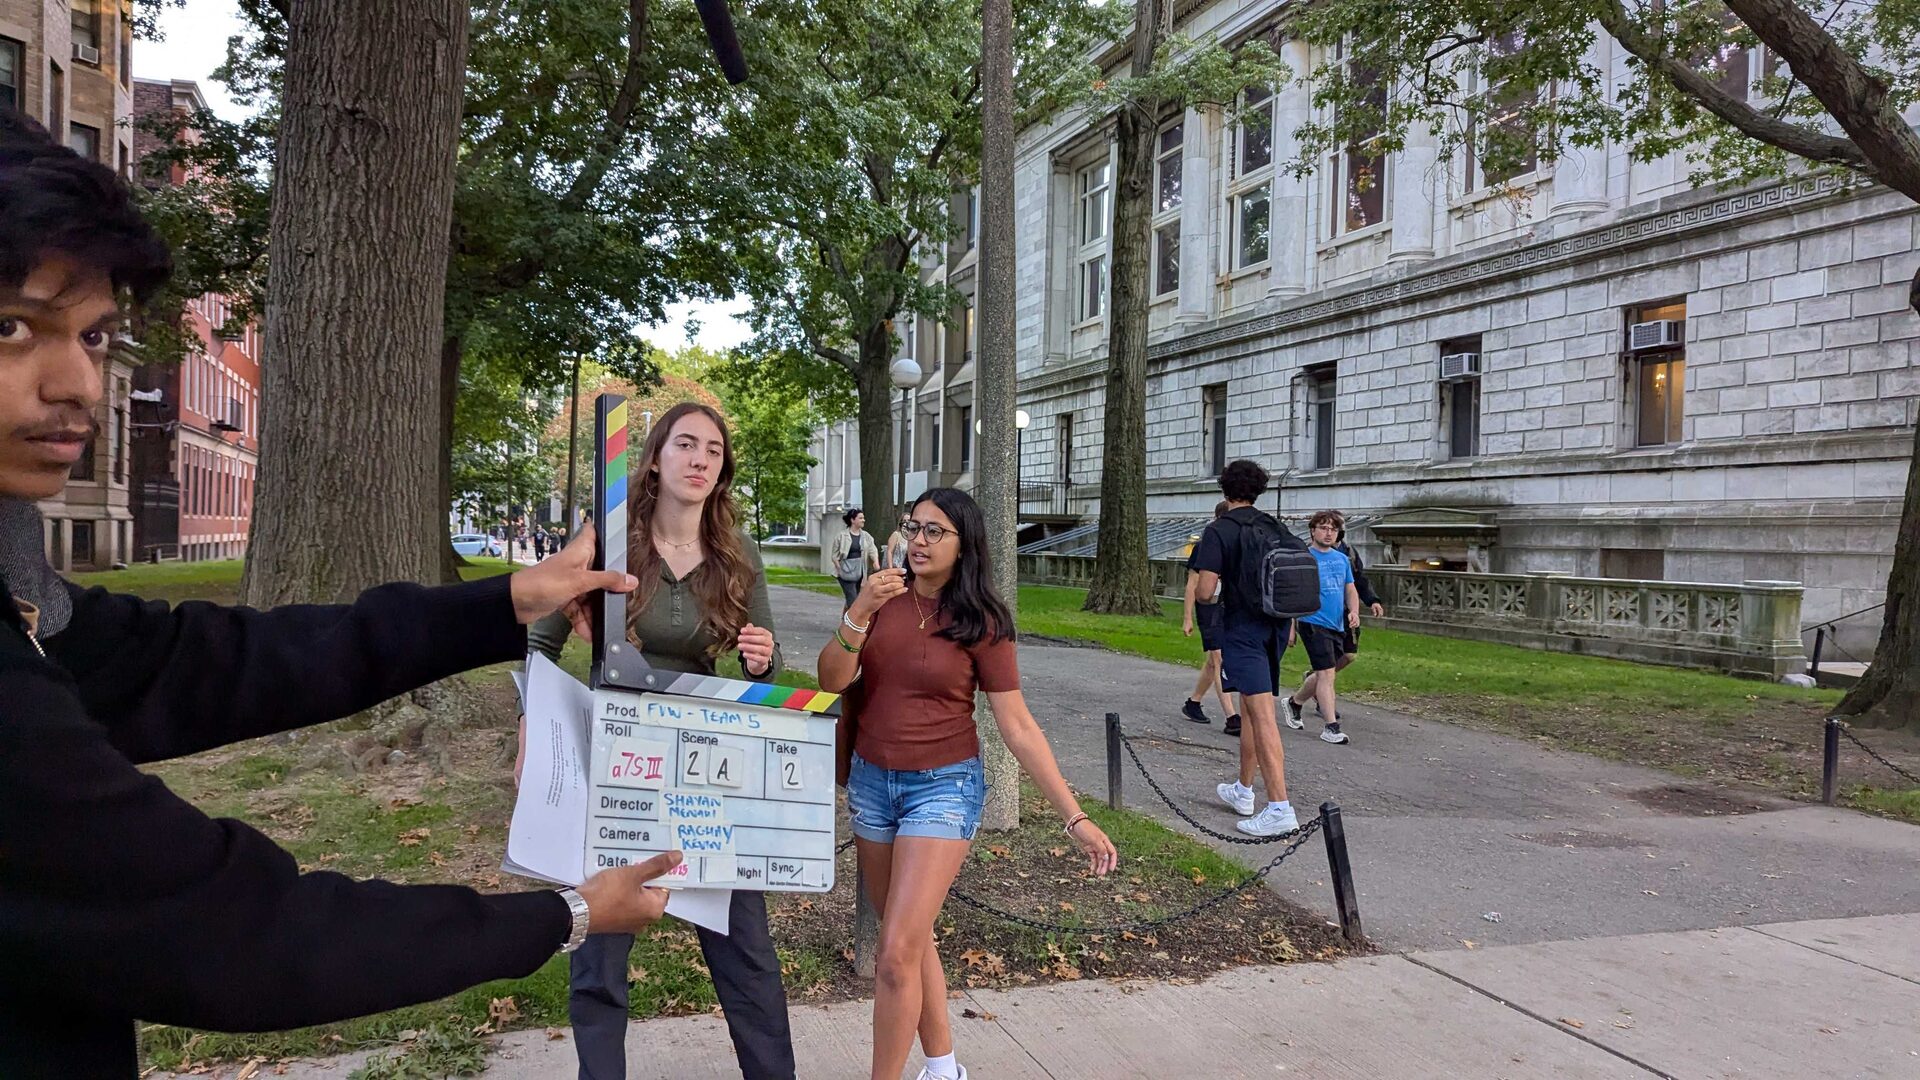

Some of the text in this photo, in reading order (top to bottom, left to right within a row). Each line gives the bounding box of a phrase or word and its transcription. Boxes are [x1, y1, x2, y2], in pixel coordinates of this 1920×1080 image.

[606, 702, 639, 718] Prod.
[700, 708, 742, 724] TEAM
[747, 713, 761, 729] 5
[605, 723, 632, 738] Roll
[681, 731, 719, 746] Scene
[768, 741, 798, 755] Take
[686, 750, 730, 781] 2 A
[784, 762, 799, 786] 2
[600, 795, 654, 812] Director
[663, 792, 722, 808] SHAYAN
[599, 826, 651, 842] Camera
[597, 853, 628, 868] Date
[771, 862, 795, 874] Sync
[736, 866, 762, 880] Night
